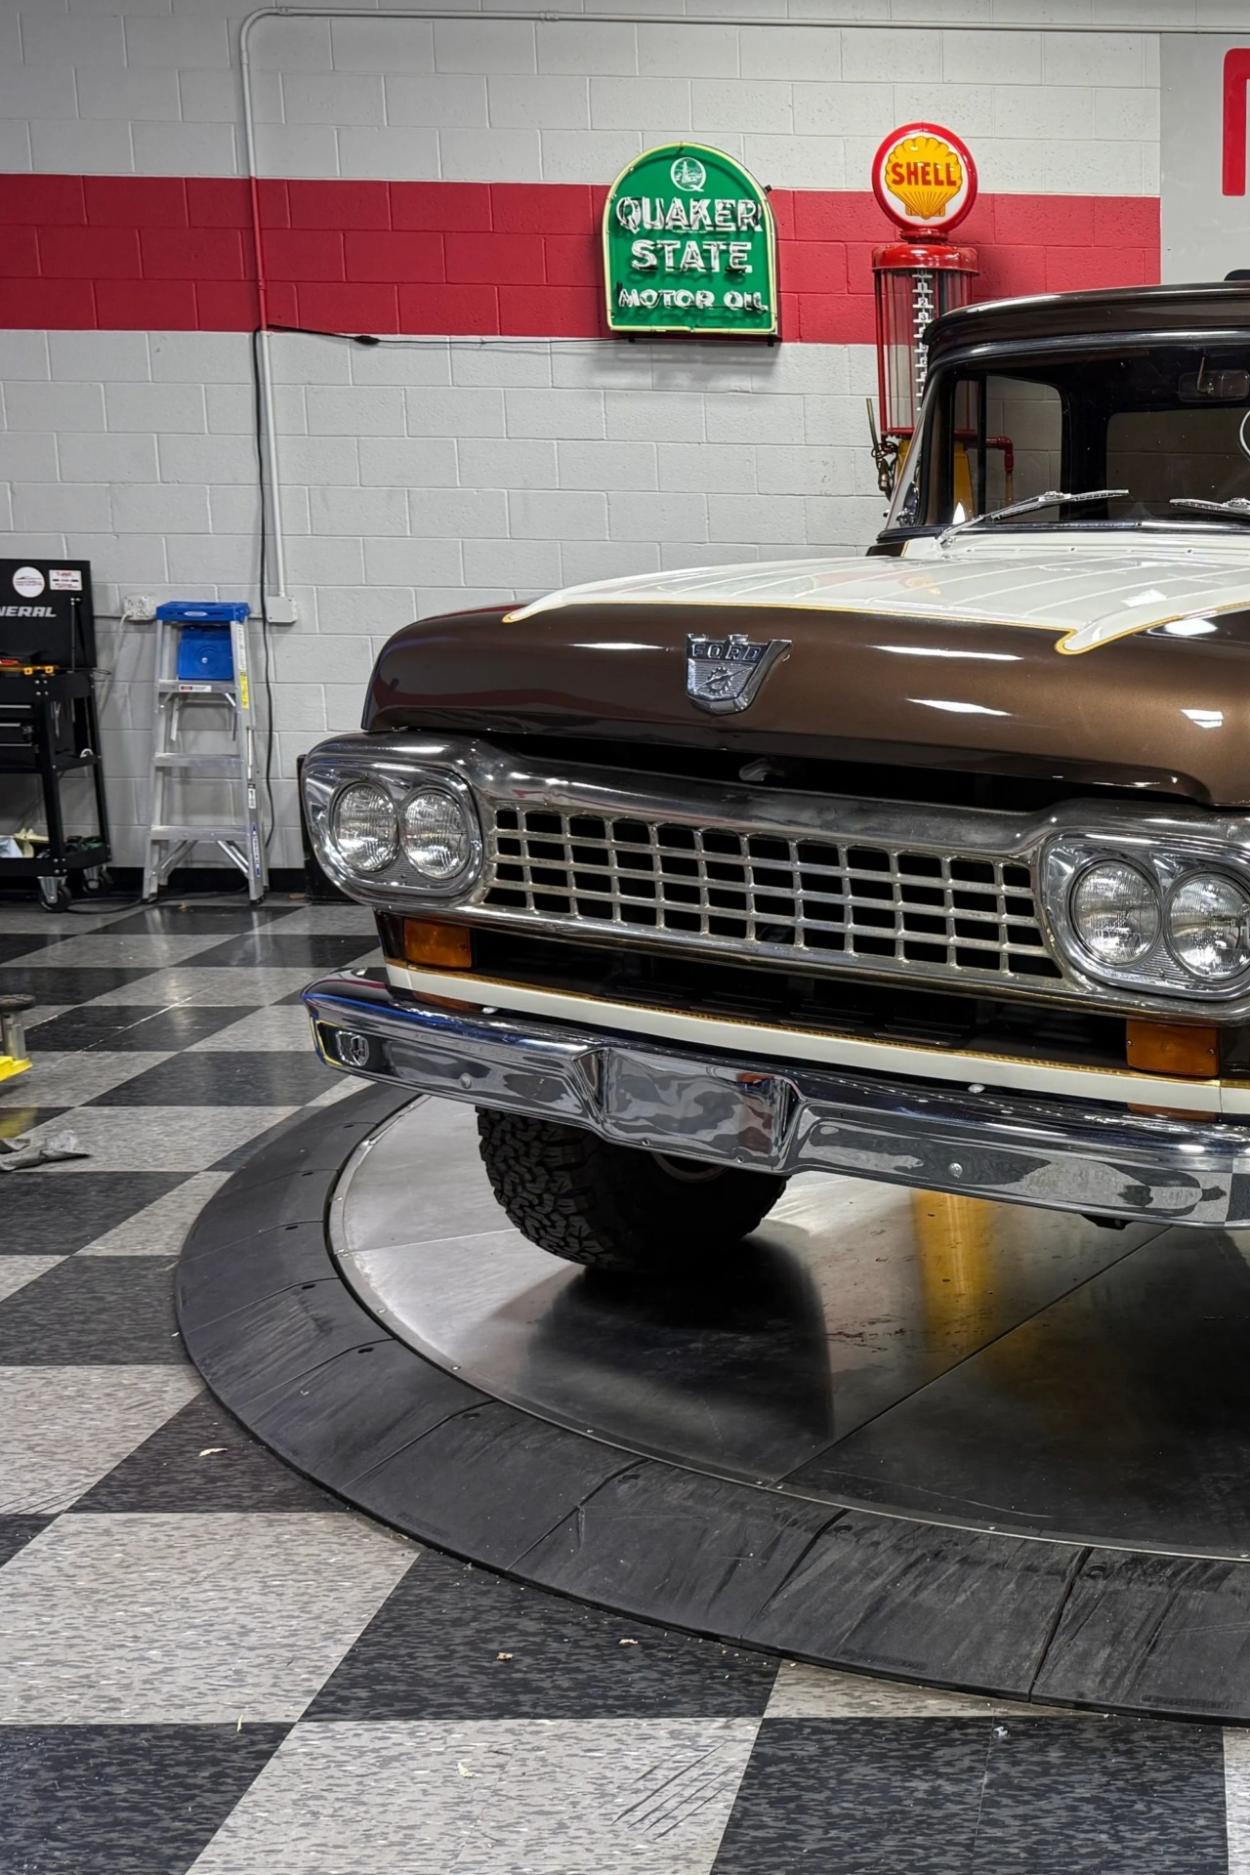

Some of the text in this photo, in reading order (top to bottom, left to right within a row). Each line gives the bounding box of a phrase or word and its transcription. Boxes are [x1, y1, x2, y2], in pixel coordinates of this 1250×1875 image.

[891, 161, 957, 187] SHELL
[616, 197, 763, 234] QUAKER
[631, 239, 753, 274] STATE
[618, 287, 769, 313] MOTOR OIL
[691, 643, 762, 662] FORD
